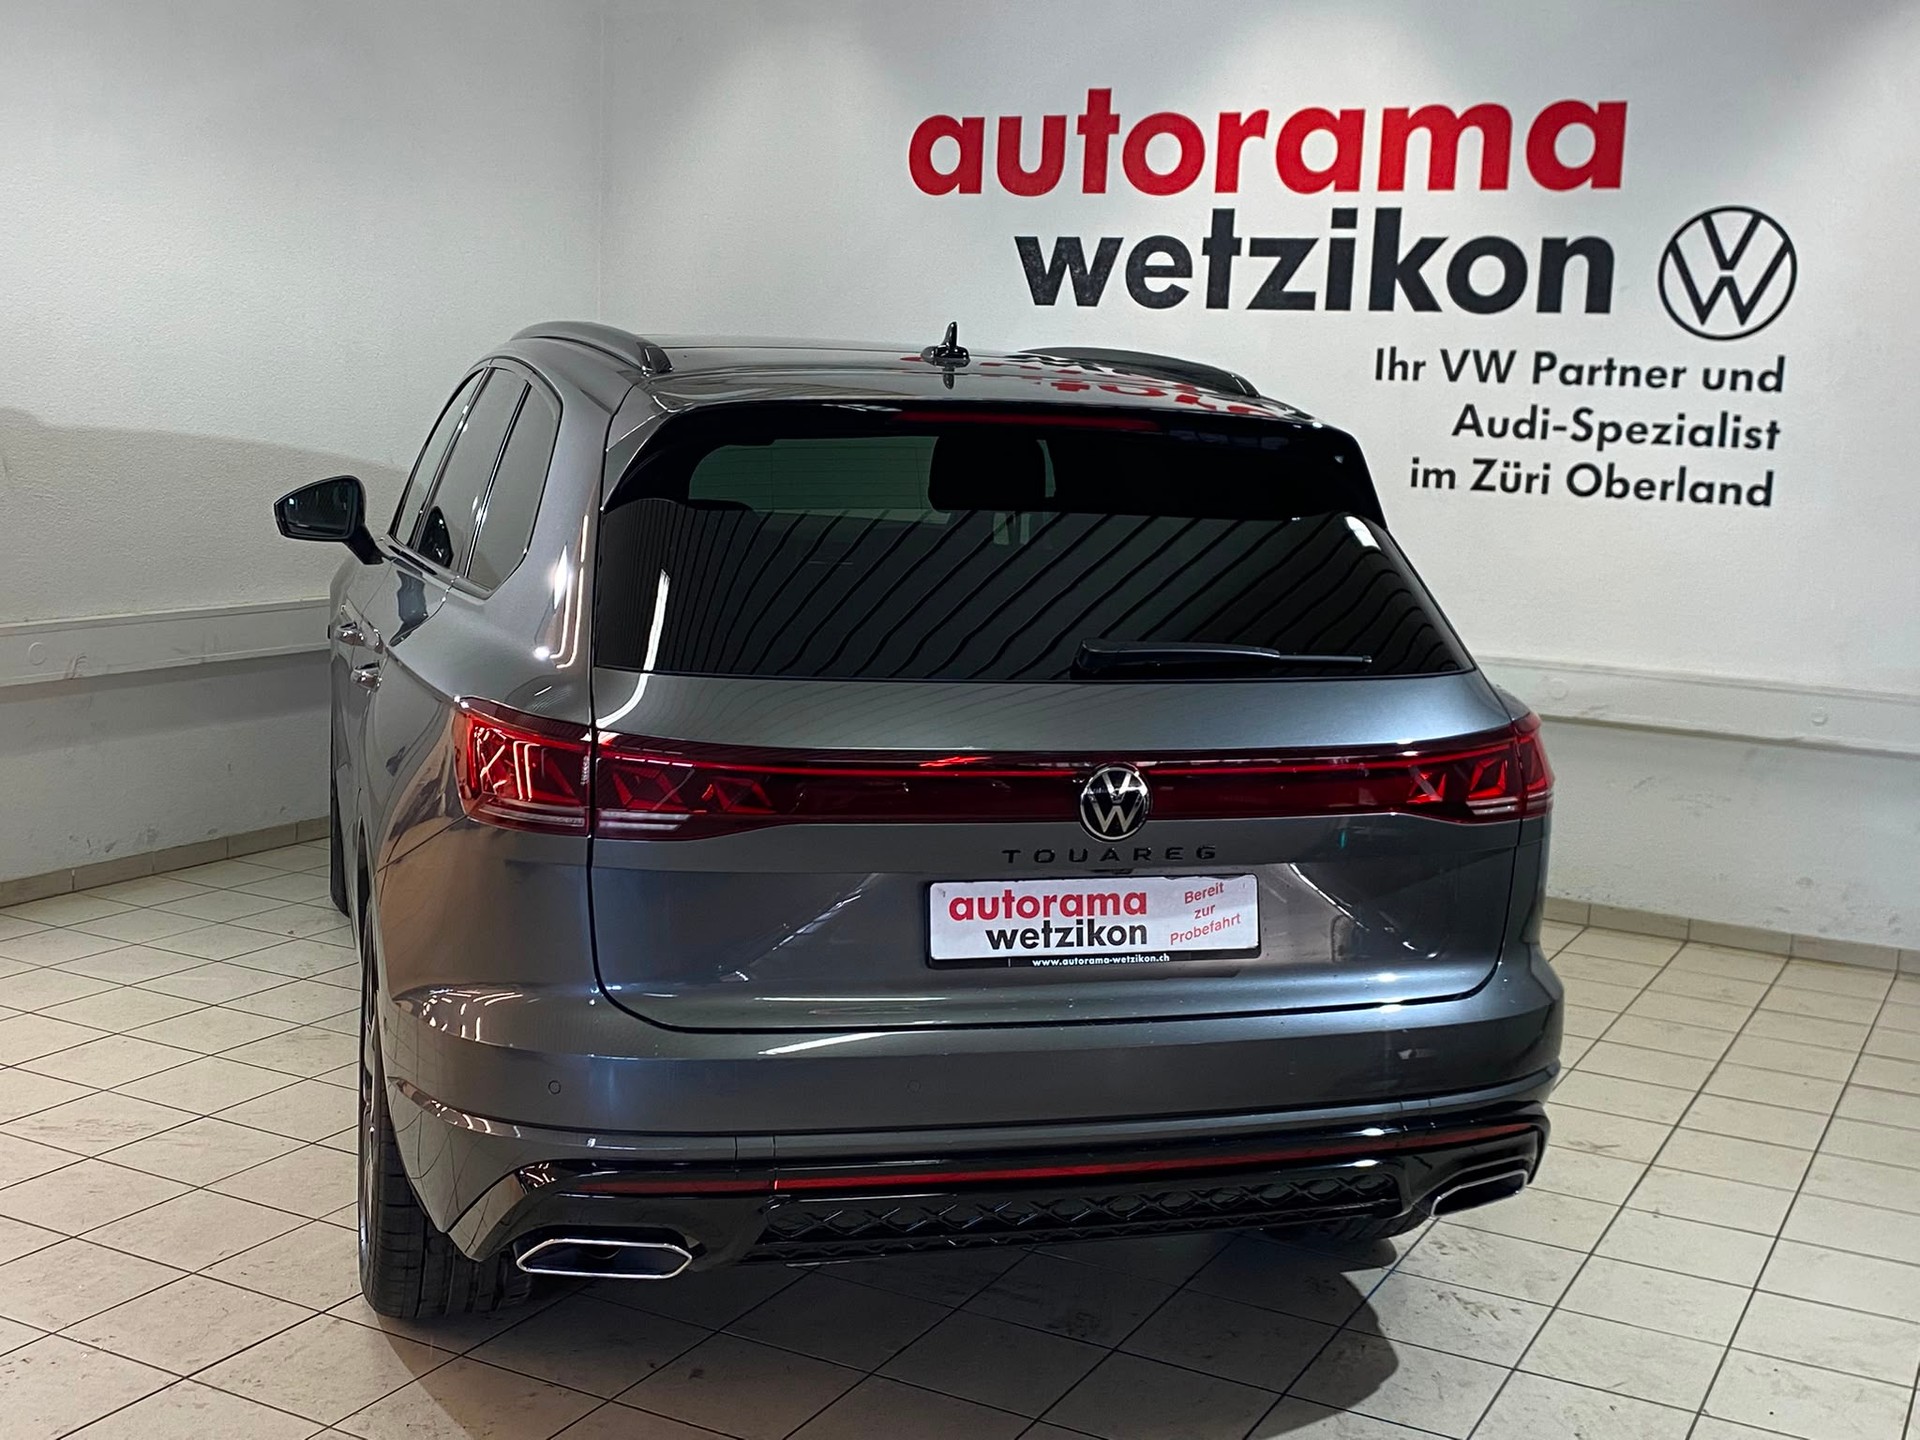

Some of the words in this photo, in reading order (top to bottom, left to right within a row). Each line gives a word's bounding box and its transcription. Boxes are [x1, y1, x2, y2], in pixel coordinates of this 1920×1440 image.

[909, 88, 1627, 195] autorama
[1014, 207, 1615, 314] wetzikon
[1374, 346, 1427, 383] Ihr
[1440, 349, 1517, 385] VW
[1532, 351, 1688, 391] Partner
[1701, 355, 1786, 393] und
[1452, 403, 1781, 451] Audi-Spezialist
[1410, 459, 1457, 491] im
[1469, 456, 1551, 497] Züri
[1565, 461, 1775, 508] Oberland
[1002, 846, 1217, 865] TOUAREG
[949, 889, 1148, 922] autorama
[1183, 881, 1225, 905] Bereit
[1194, 903, 1216, 920] zur
[985, 919, 1148, 950] wetzikon
[1170, 912, 1241, 946] Probefahrt
[1032, 952, 1171, 968] www.autorama-wetzikon.ch
